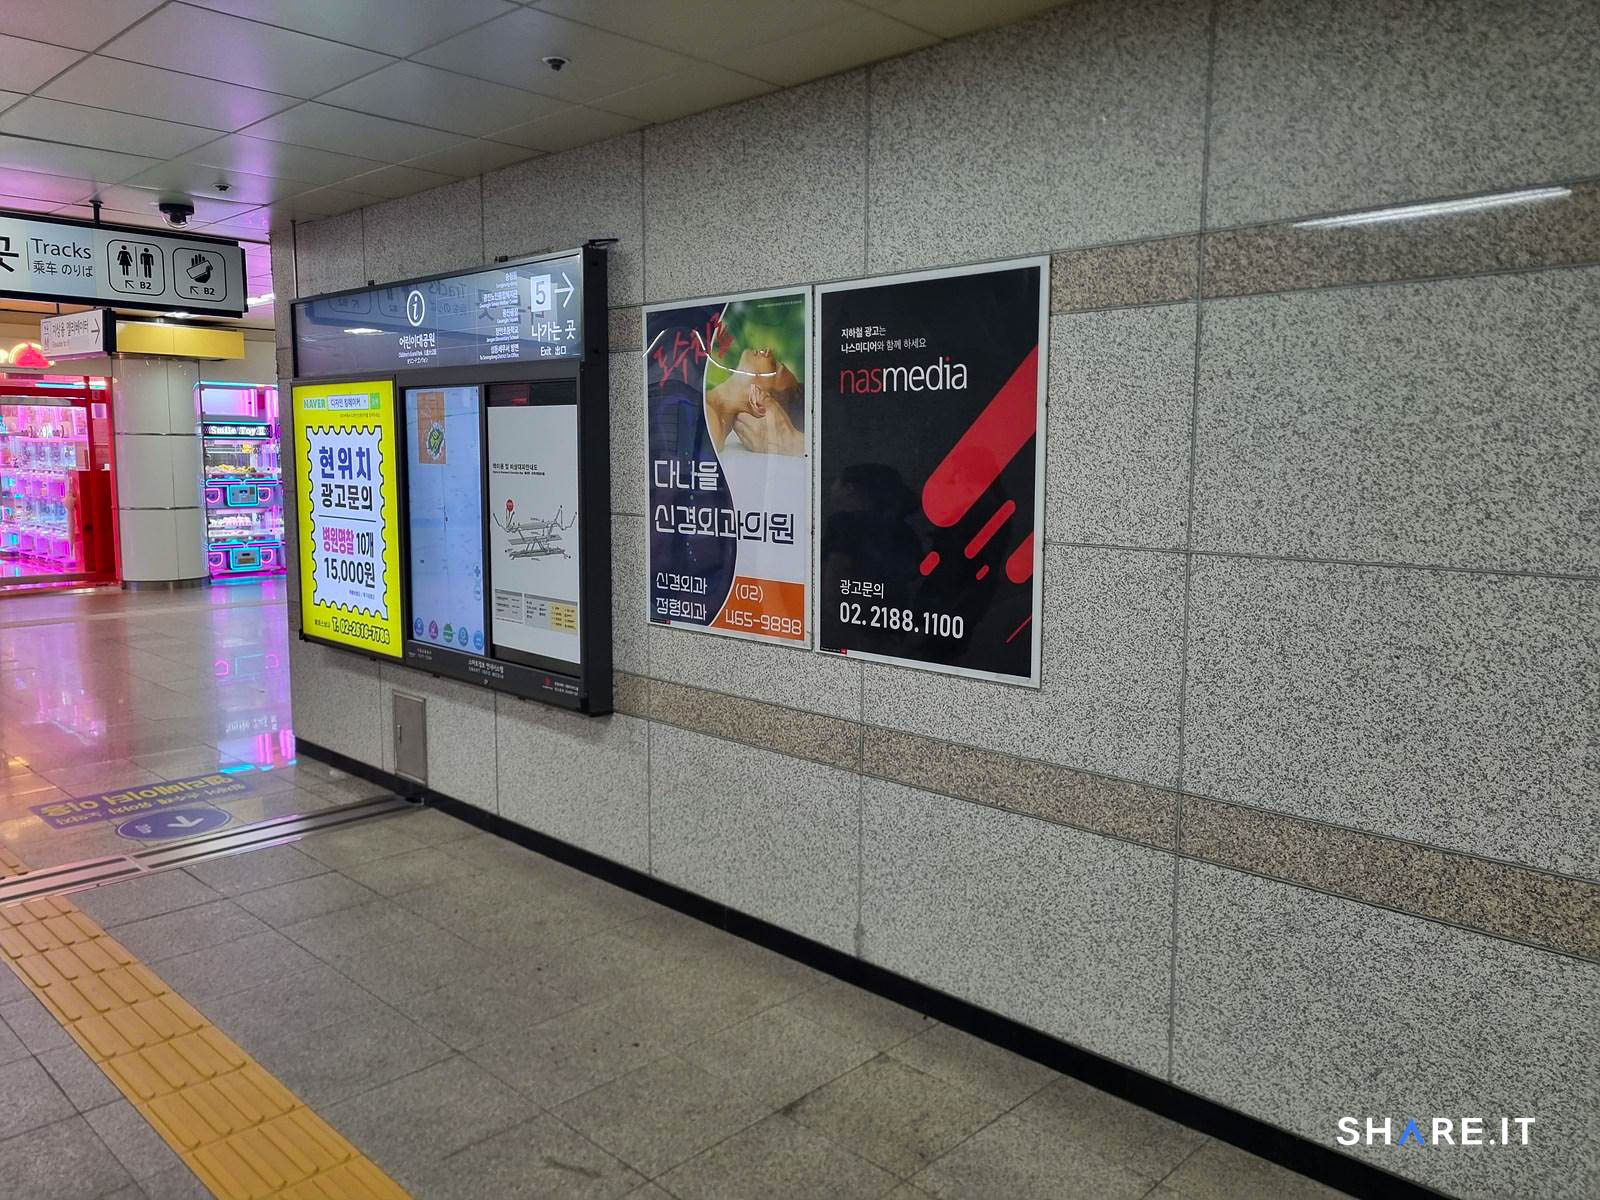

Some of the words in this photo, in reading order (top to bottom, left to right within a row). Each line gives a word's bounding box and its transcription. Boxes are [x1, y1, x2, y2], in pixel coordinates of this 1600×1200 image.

[30, 237, 92, 259] Tracks
[61, 264, 94, 278] のりば
[140, 281, 152, 290] B2
[204, 287, 216, 296] B2
[535, 281, 546, 305] 5
[399, 332, 435, 349] 어린이대공원
[531, 321, 562, 342] 나가는
[565, 319, 576, 340] 곳
[841, 327, 863, 339] 지하철
[864, 325, 887, 338] 광고는
[540, 346, 552, 356] Exit
[555, 345, 567, 356] 出口
[841, 340, 885, 354] 나스미디어와
[886, 339, 901, 351] 함께
[903, 337, 927, 349] 하세요
[839, 356, 968, 394] nasmedia
[304, 399, 326, 408] NAVER
[318, 445, 372, 482] 현위치
[654, 459, 719, 491] 다나을
[320, 482, 374, 512] 광고문의
[654, 504, 794, 545] 신경외과의원
[322, 526, 355, 556] 병원명찰
[355, 532, 375, 559] 10개
[323, 557, 376, 589] 15,000원
[656, 572, 707, 595] 신경외과
[735, 583, 764, 603] (02)
[840, 579, 884, 599] 광고문의
[655, 596, 707, 621] 정형외과
[725, 609, 803, 635] 465-9898
